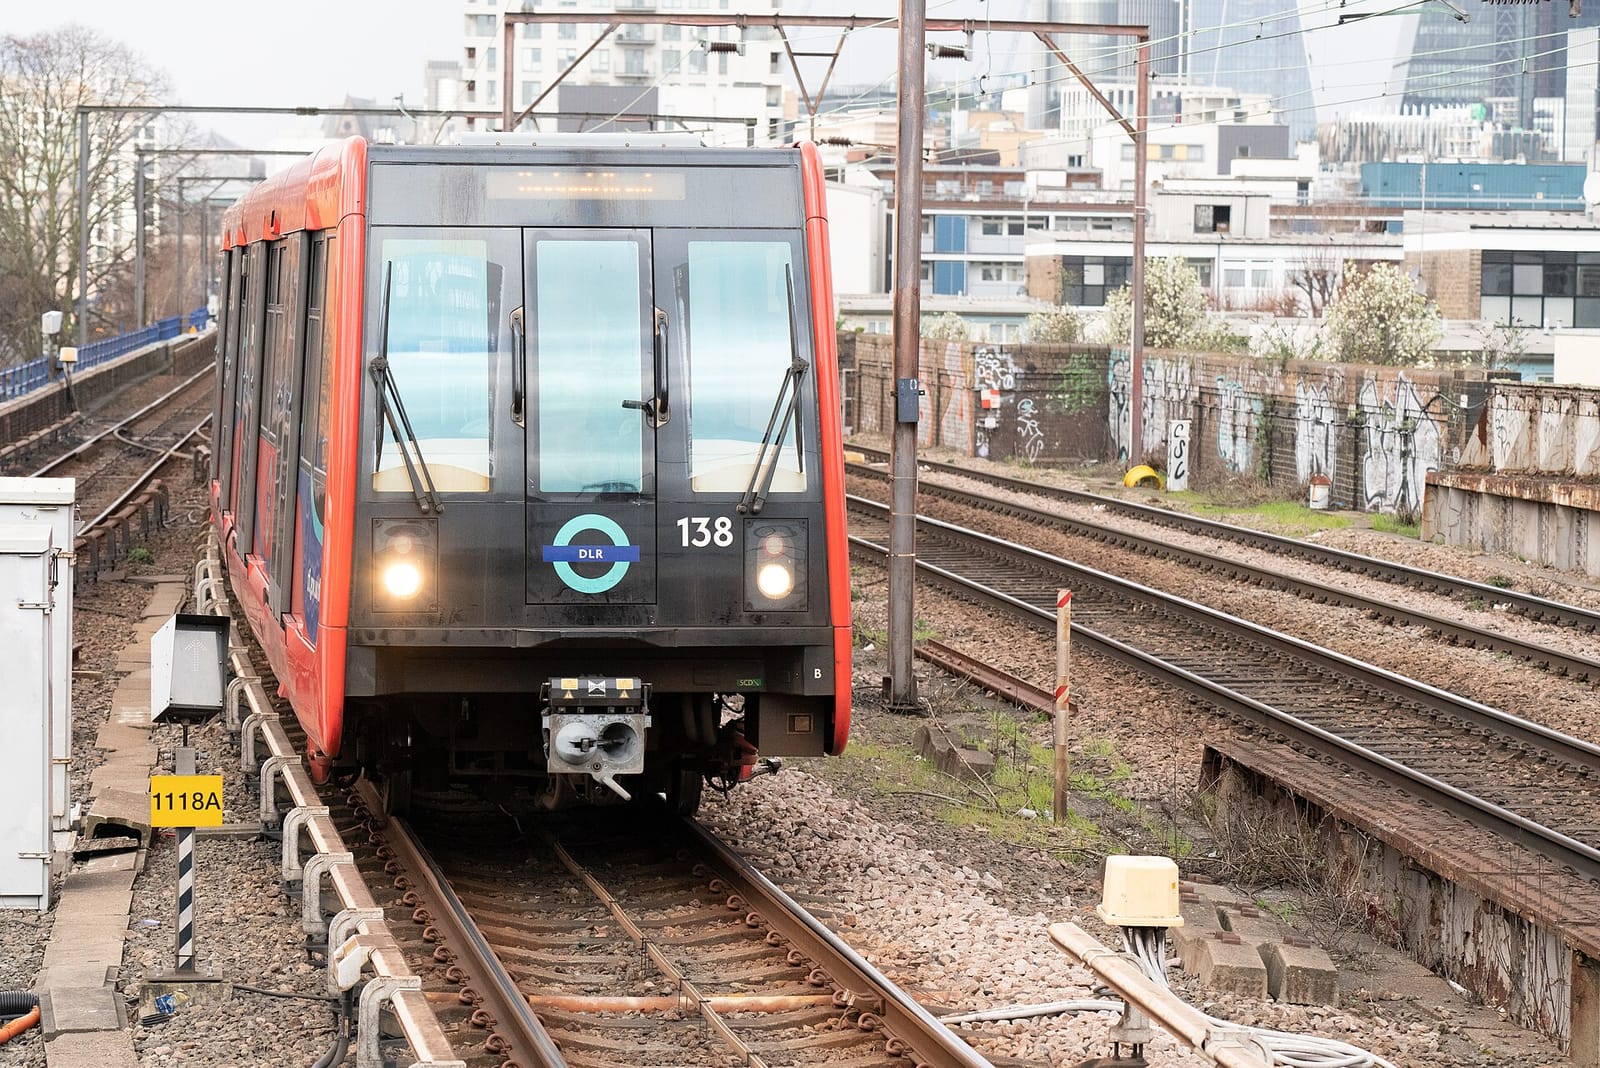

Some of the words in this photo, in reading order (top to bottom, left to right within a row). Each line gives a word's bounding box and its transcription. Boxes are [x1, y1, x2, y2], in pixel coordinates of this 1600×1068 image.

[676, 516, 734, 548] 138
[578, 548, 604, 559] DLR
[813, 668, 822, 679] B
[152, 791, 221, 811] 1118A
